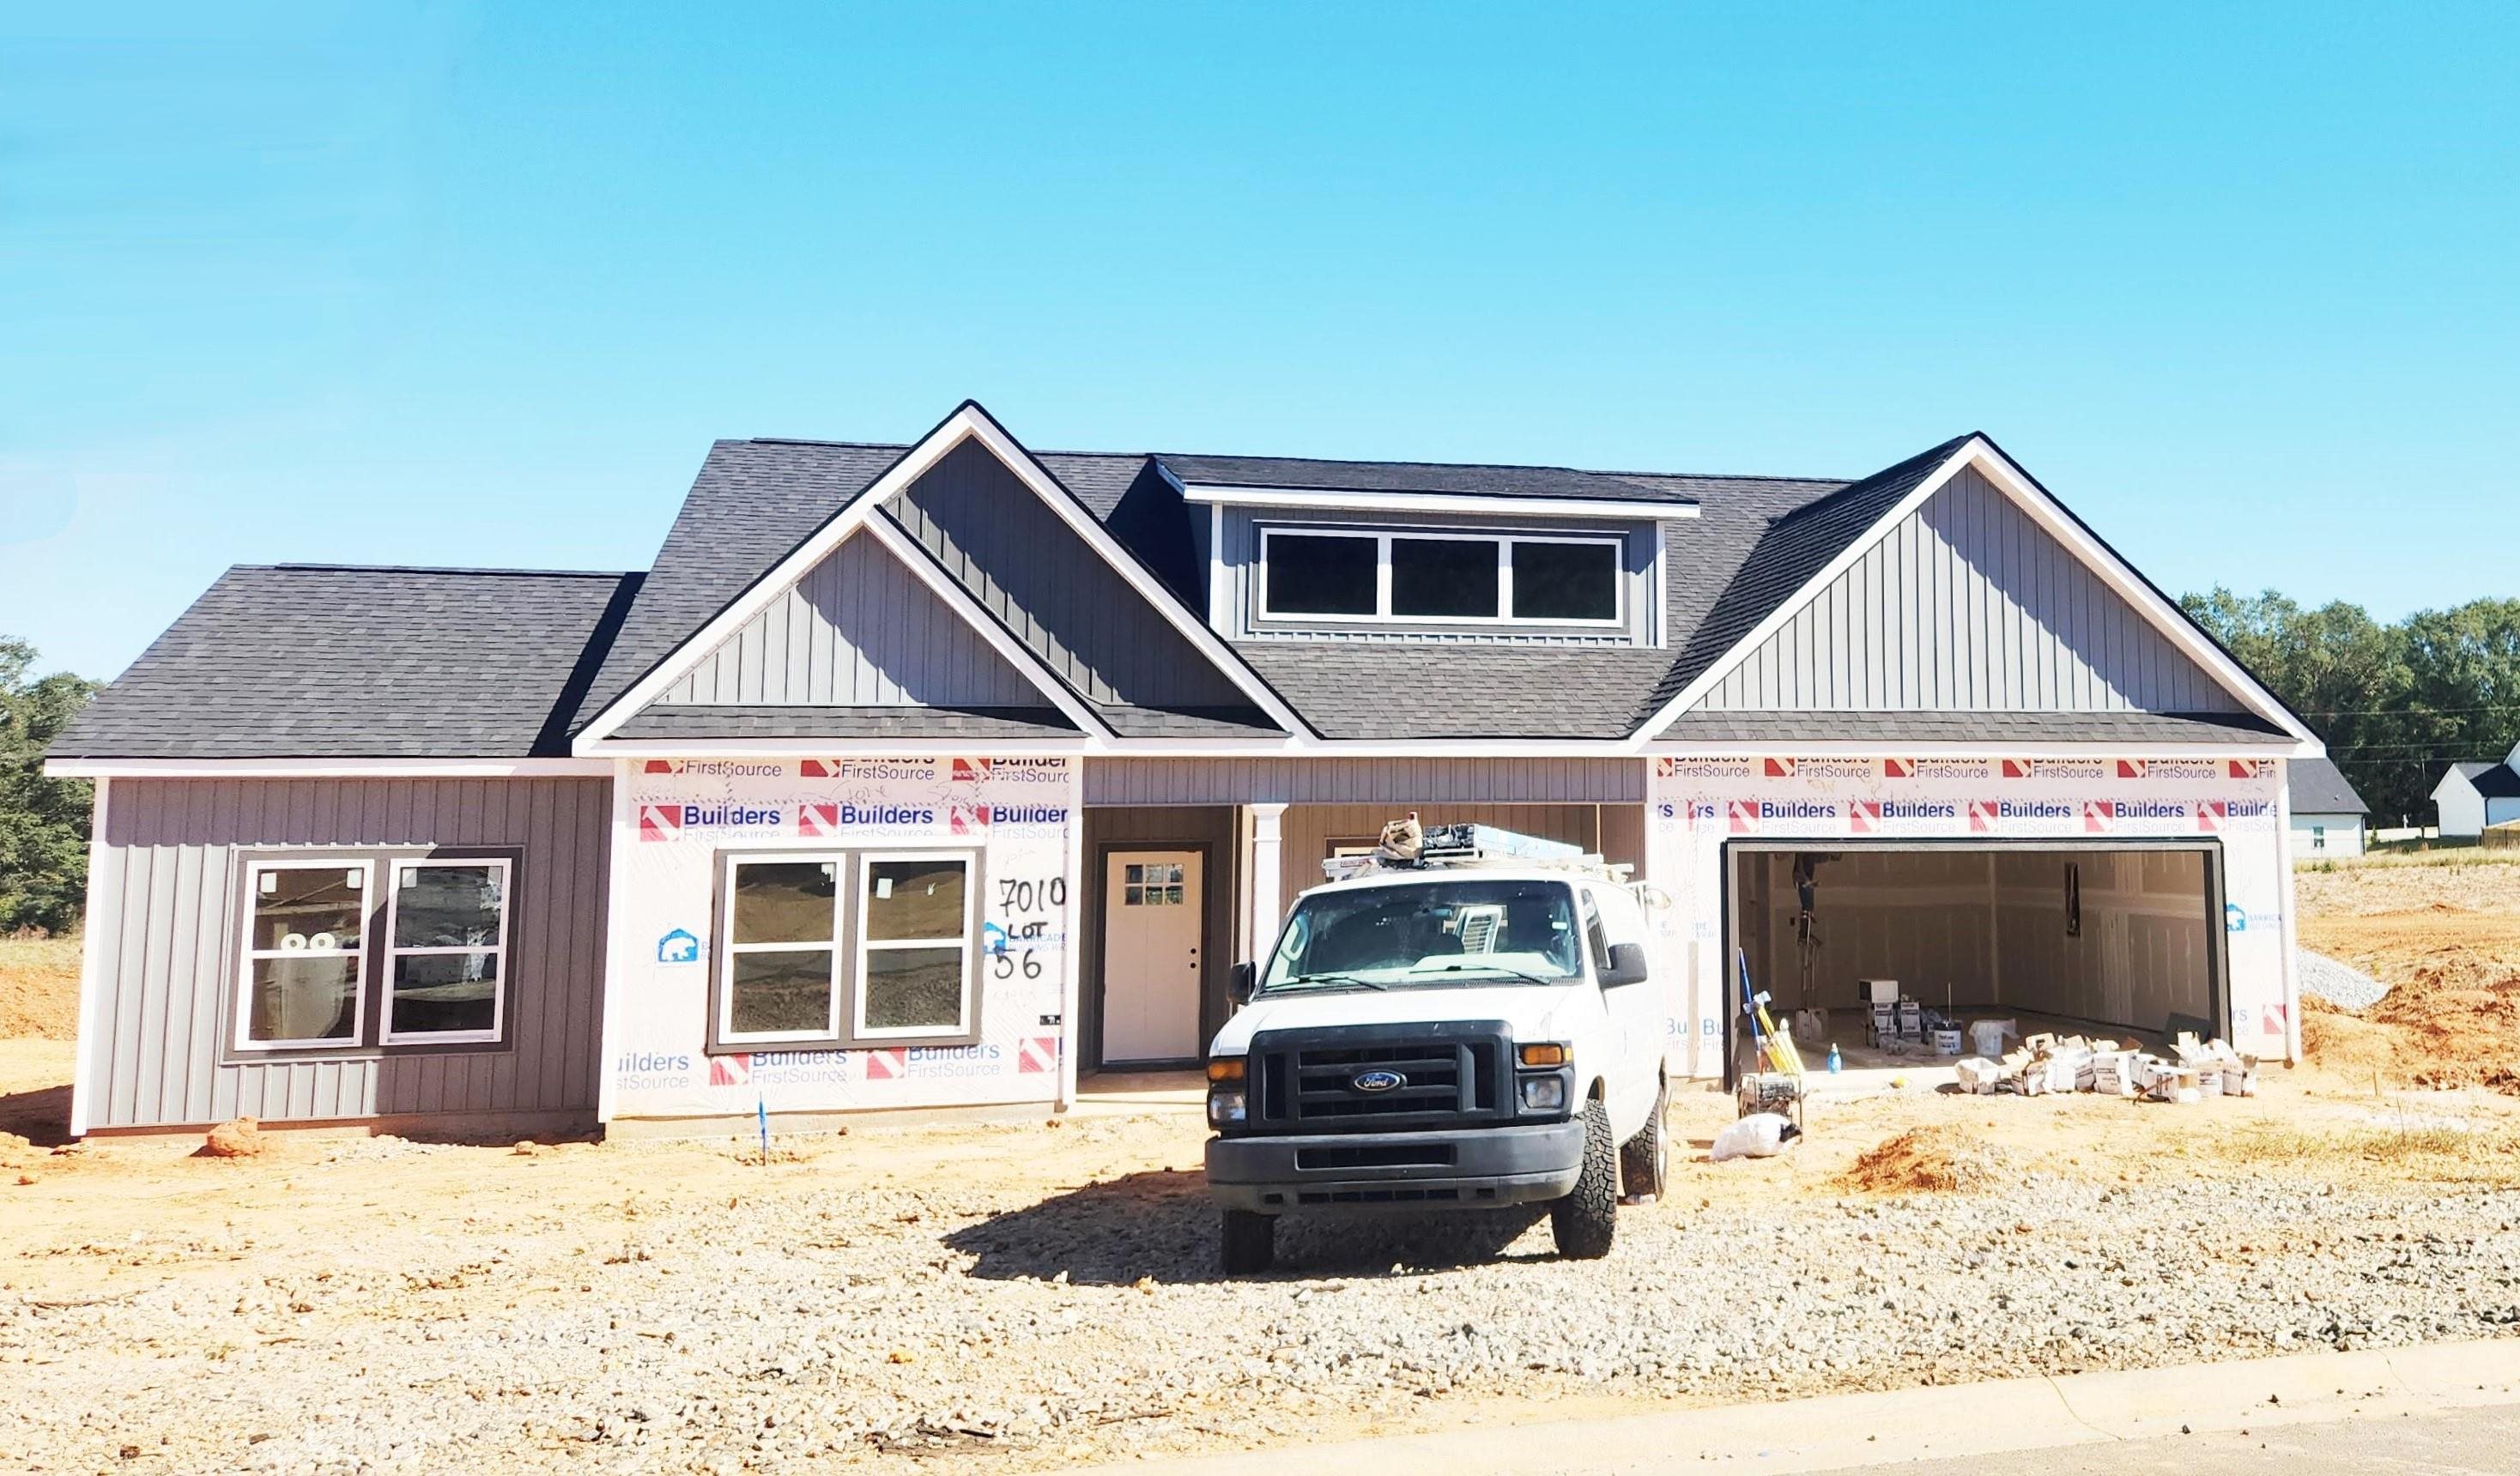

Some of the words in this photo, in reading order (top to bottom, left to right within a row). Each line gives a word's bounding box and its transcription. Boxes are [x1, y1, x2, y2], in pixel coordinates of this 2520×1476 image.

[687, 761, 782, 777] FirstSource
[842, 764, 935, 781] FirstSource
[1675, 765, 1750, 778] FirstSource
[1797, 765, 1871, 778] FirstSource
[1917, 765, 1989, 778] FirstSource
[2033, 765, 2104, 778] FirstSource
[2147, 766, 2216, 779] FirstSource
[685, 806, 780, 825] Builders
[842, 806, 934, 824] Builders
[1762, 802, 1836, 818] Builders
[1882, 802, 1955, 818] Builders
[2001, 802, 2071, 818] Builders
[2116, 802, 2184, 818] Builders
[1762, 820, 1837, 833] FirstSource
[1883, 820, 1956, 833] FirstSource
[2001, 820, 2072, 833] FirstSource
[2116, 820, 2185, 833] FirstSource
[1000, 877, 1066, 917] 7010
[1008, 922, 1048, 939] LOT
[751, 1068, 847, 1085] FirstSource
[907, 1062, 1001, 1079] FirstSource
[1364, 1076, 1389, 1087] Ford
